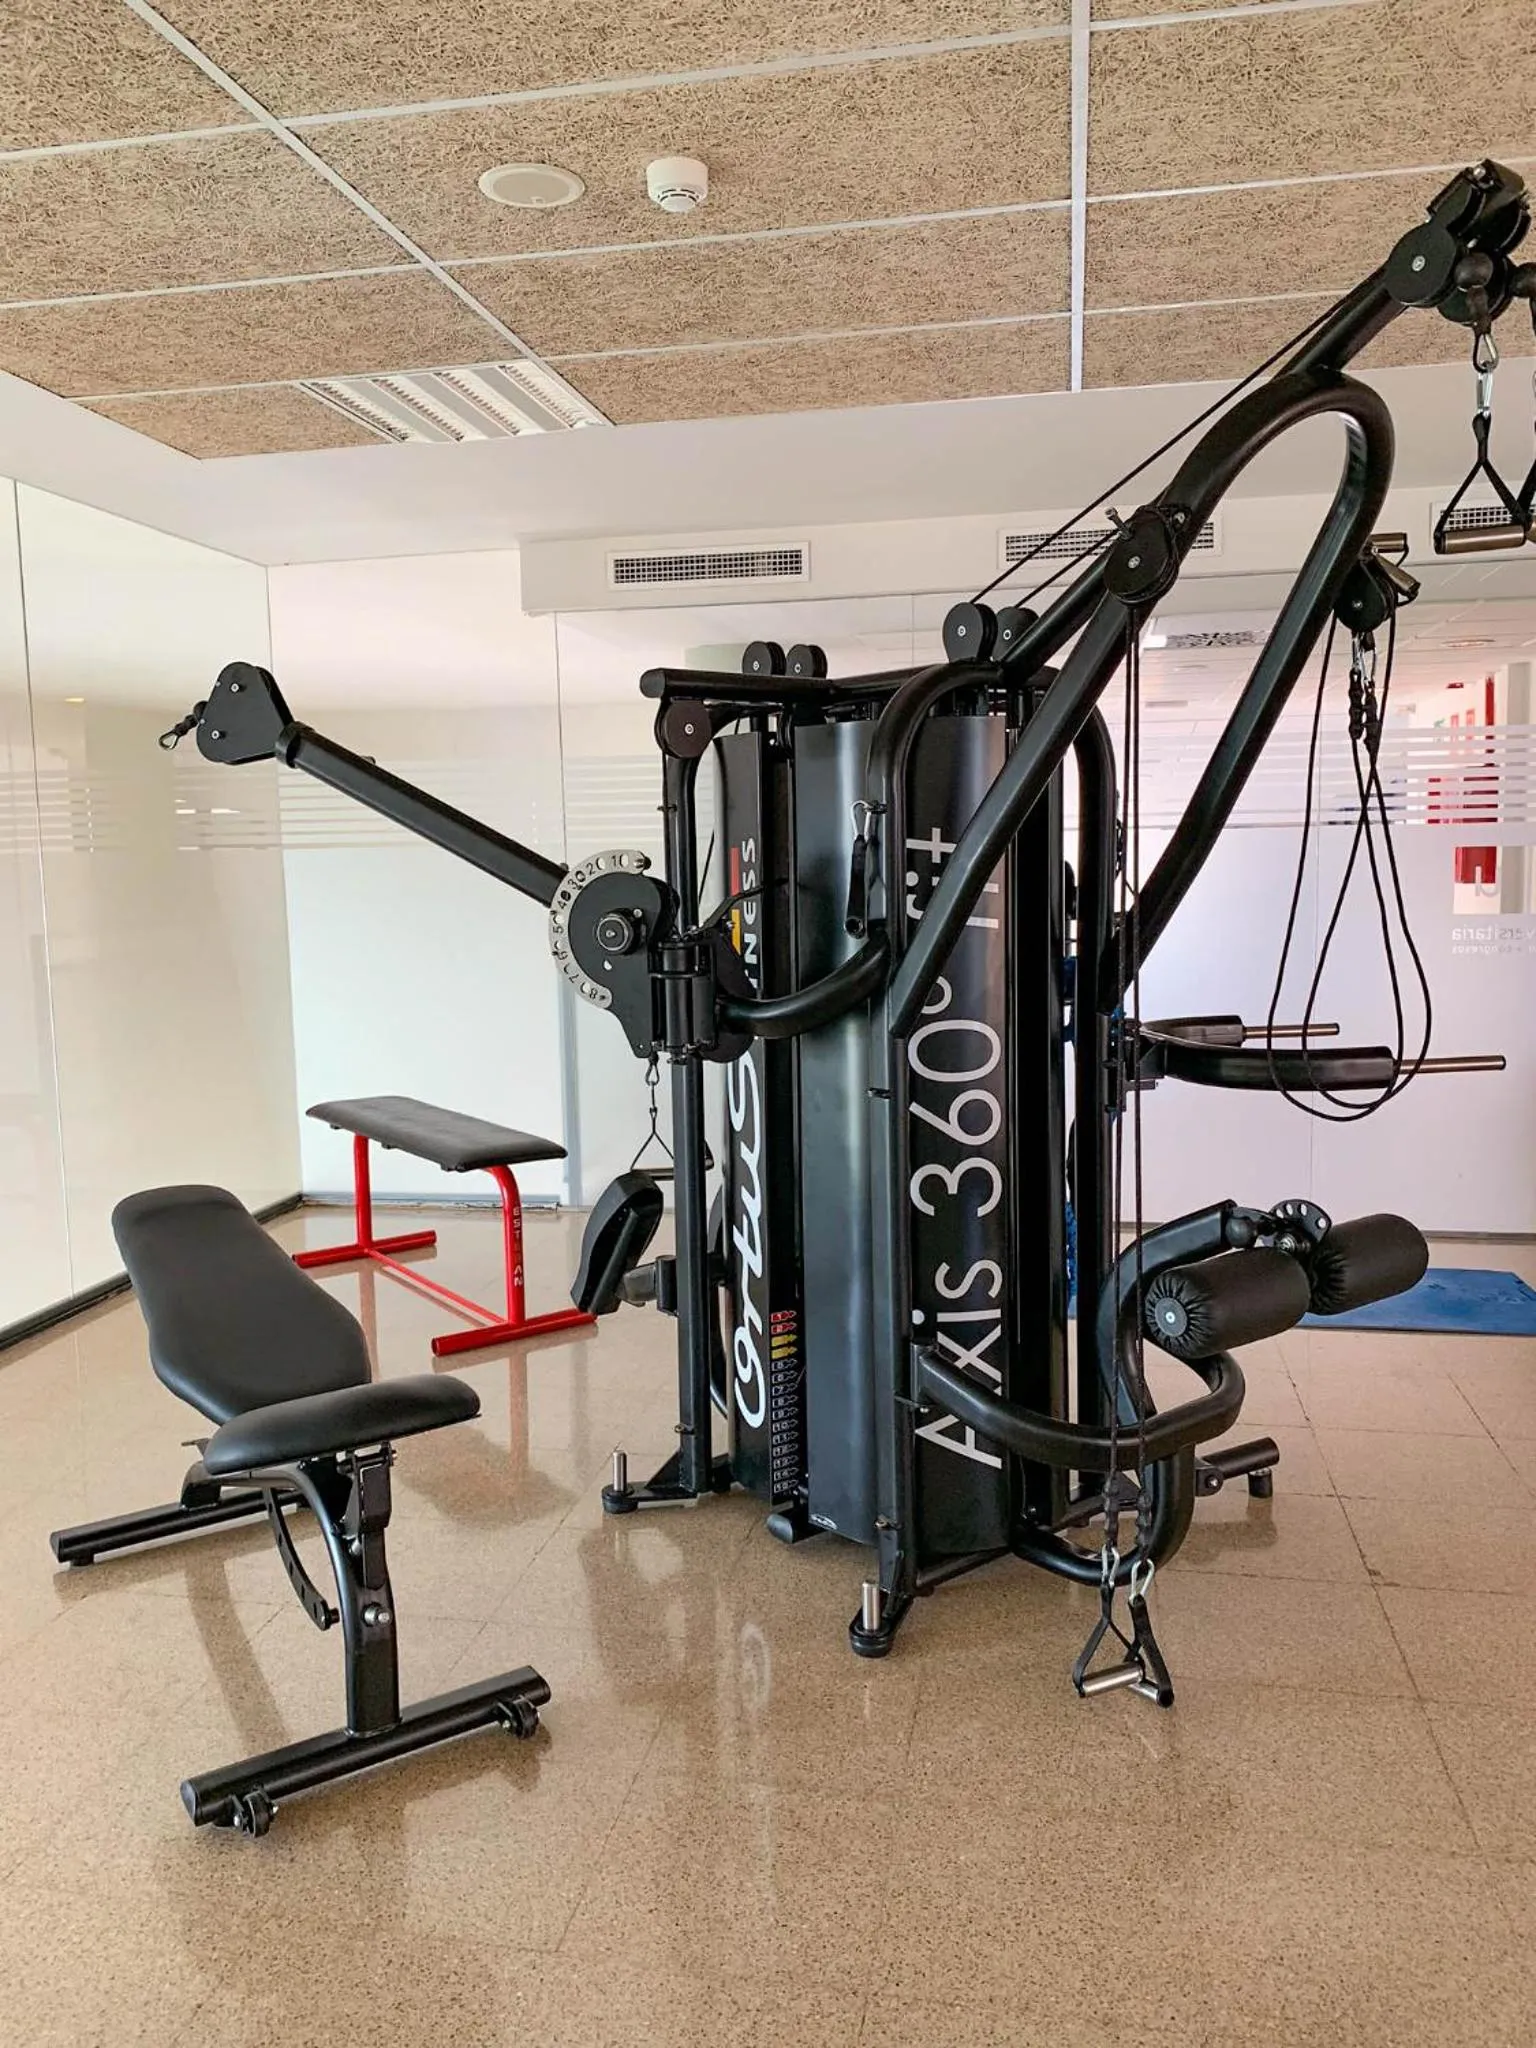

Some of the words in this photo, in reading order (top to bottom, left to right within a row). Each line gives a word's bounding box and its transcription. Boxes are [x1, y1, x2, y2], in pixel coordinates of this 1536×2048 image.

[553, 925, 564, 934] 5
[586, 862, 596, 876] 2
[742, 837, 758, 989] NESS
[727, 1050, 766, 1428] Ortus
[911, 1259, 1003, 1469] Axis
